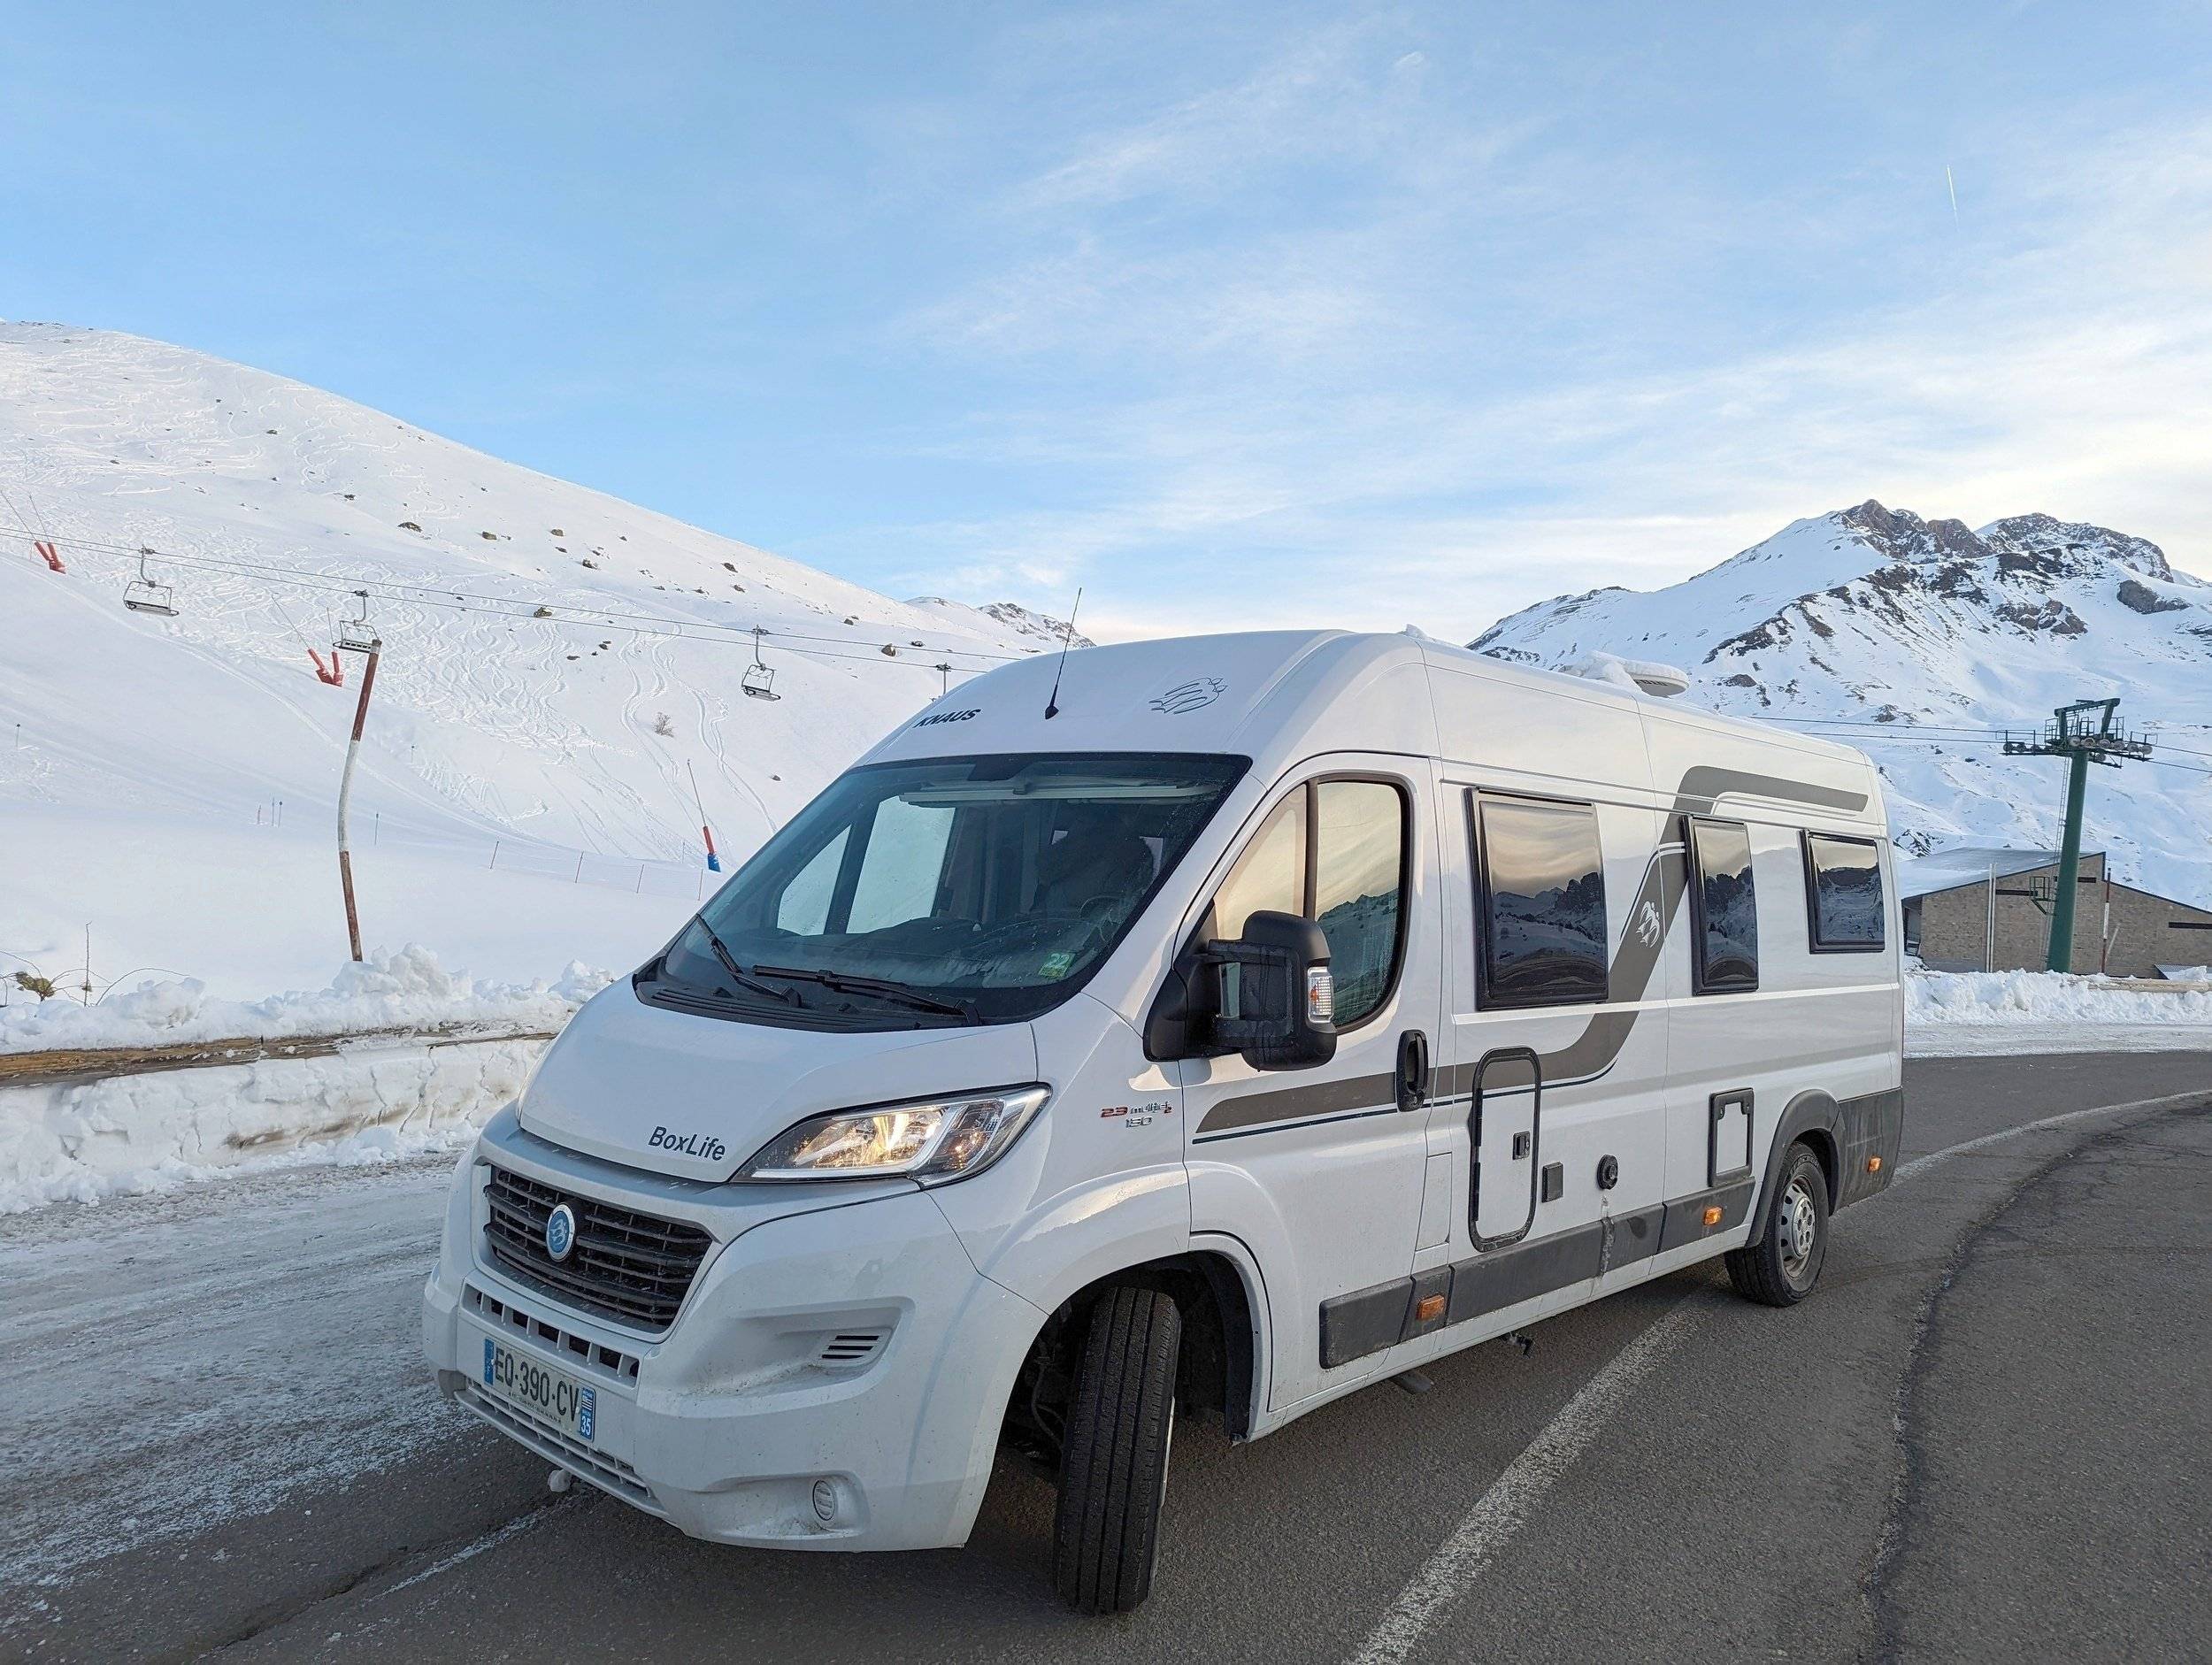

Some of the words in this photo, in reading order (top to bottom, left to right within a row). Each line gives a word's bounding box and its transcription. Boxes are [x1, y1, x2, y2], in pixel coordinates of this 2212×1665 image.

[912, 709, 981, 728] KNAUS
[648, 1125, 726, 1161] BoxLife
[580, 1415, 591, 1436] 35
